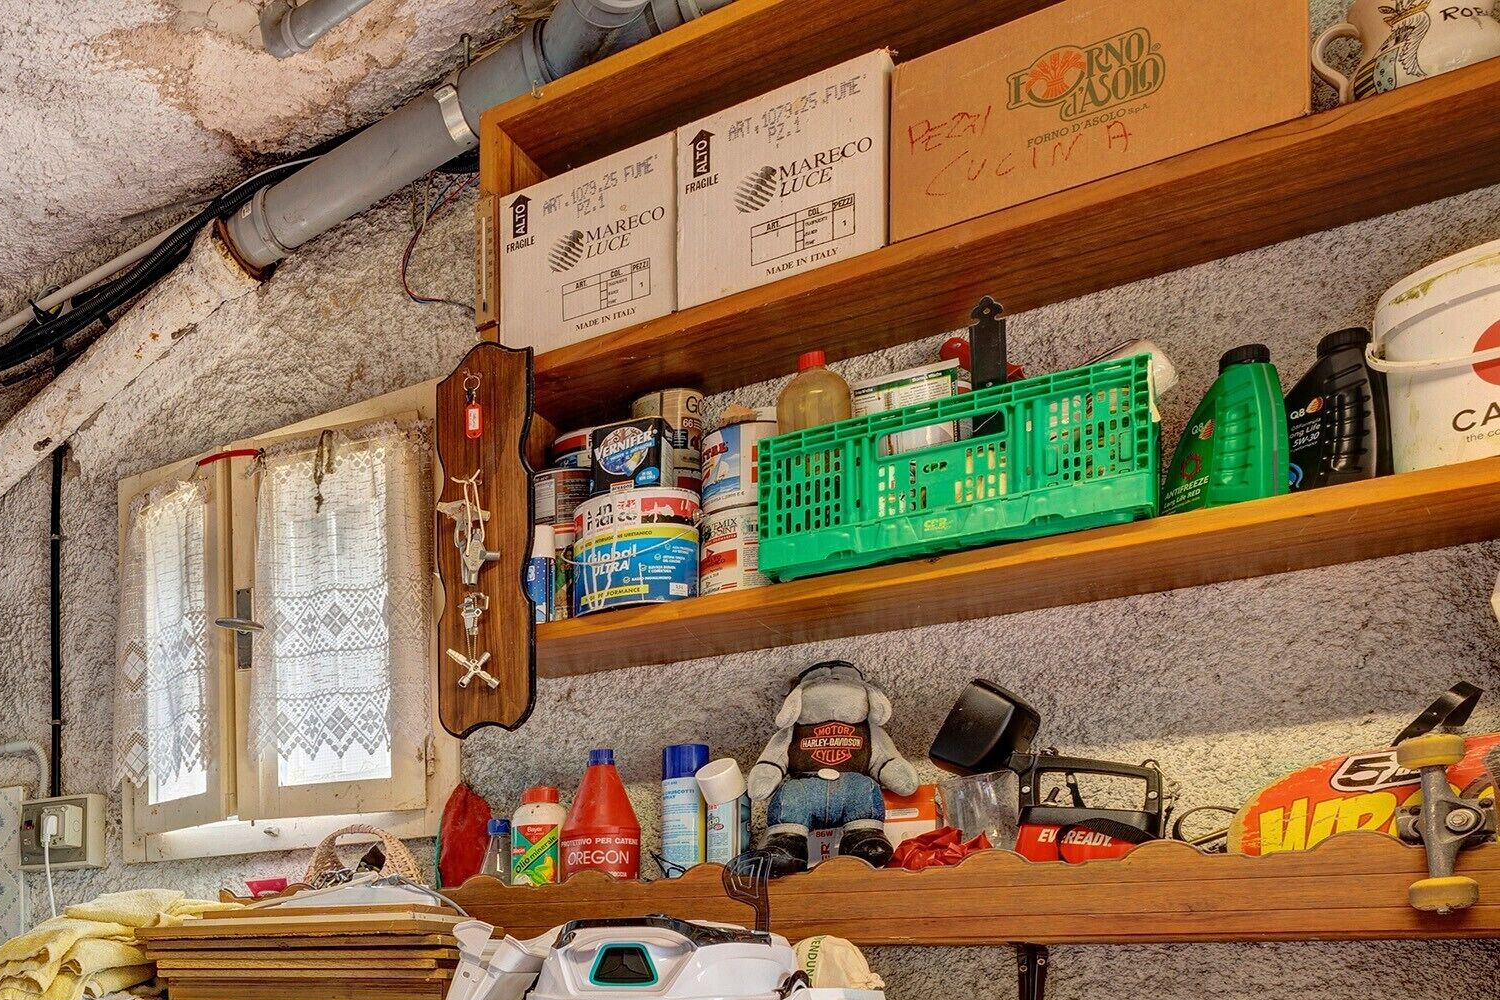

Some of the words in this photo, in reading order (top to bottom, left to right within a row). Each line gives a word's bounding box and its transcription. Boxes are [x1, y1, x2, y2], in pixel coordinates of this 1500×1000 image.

[1026, 128, 1069, 149] FORNO
[1071, 108, 1127, 134] D'ASOLO
[696, 140, 708, 174] ALTO
[778, 136, 873, 182] MARECO
[685, 173, 720, 195] FRAGILE
[780, 166, 833, 198] LUCE
[515, 203, 527, 235] ALTO
[585, 206, 665, 244] MARECO
[766, 221, 781, 232] ART.
[808, 207, 823, 217] COL.
[506, 235, 536, 254] FRAGILE
[585, 232, 632, 260] LUCE
[766, 261, 794, 276] MADE
[796, 256, 808, 267] IN
[810, 247, 838, 264] ITALY
[610, 269, 624, 279] COL.
[575, 317, 600, 331] MADE
[601, 312, 611, 324] IN
[612, 306, 637, 321] ITALY
[1290, 408, 1306, 420] Q8
[1192, 422, 1204, 436] Q8
[1305, 423, 1321, 434] Life
[1466, 433, 1484, 442] the
[594, 428, 652, 461] VERNIFER
[1292, 431, 1320, 448] 5W-30
[1164, 475, 1210, 500] ANTIFREEZE
[1187, 488, 1201, 500] RED
[818, 725, 851, 737] MOTOR
[802, 737, 861, 749] HARLEY-DAVIDSON
[815, 749, 846, 763] CYCLES
[595, 837, 613, 845] PER
[614, 837, 639, 846] CATENE
[1037, 828, 1112, 848] EVREADY.
[515, 857, 532, 874] Olio
[530, 834, 557, 861] minerale
[567, 849, 630, 866] OREGON
